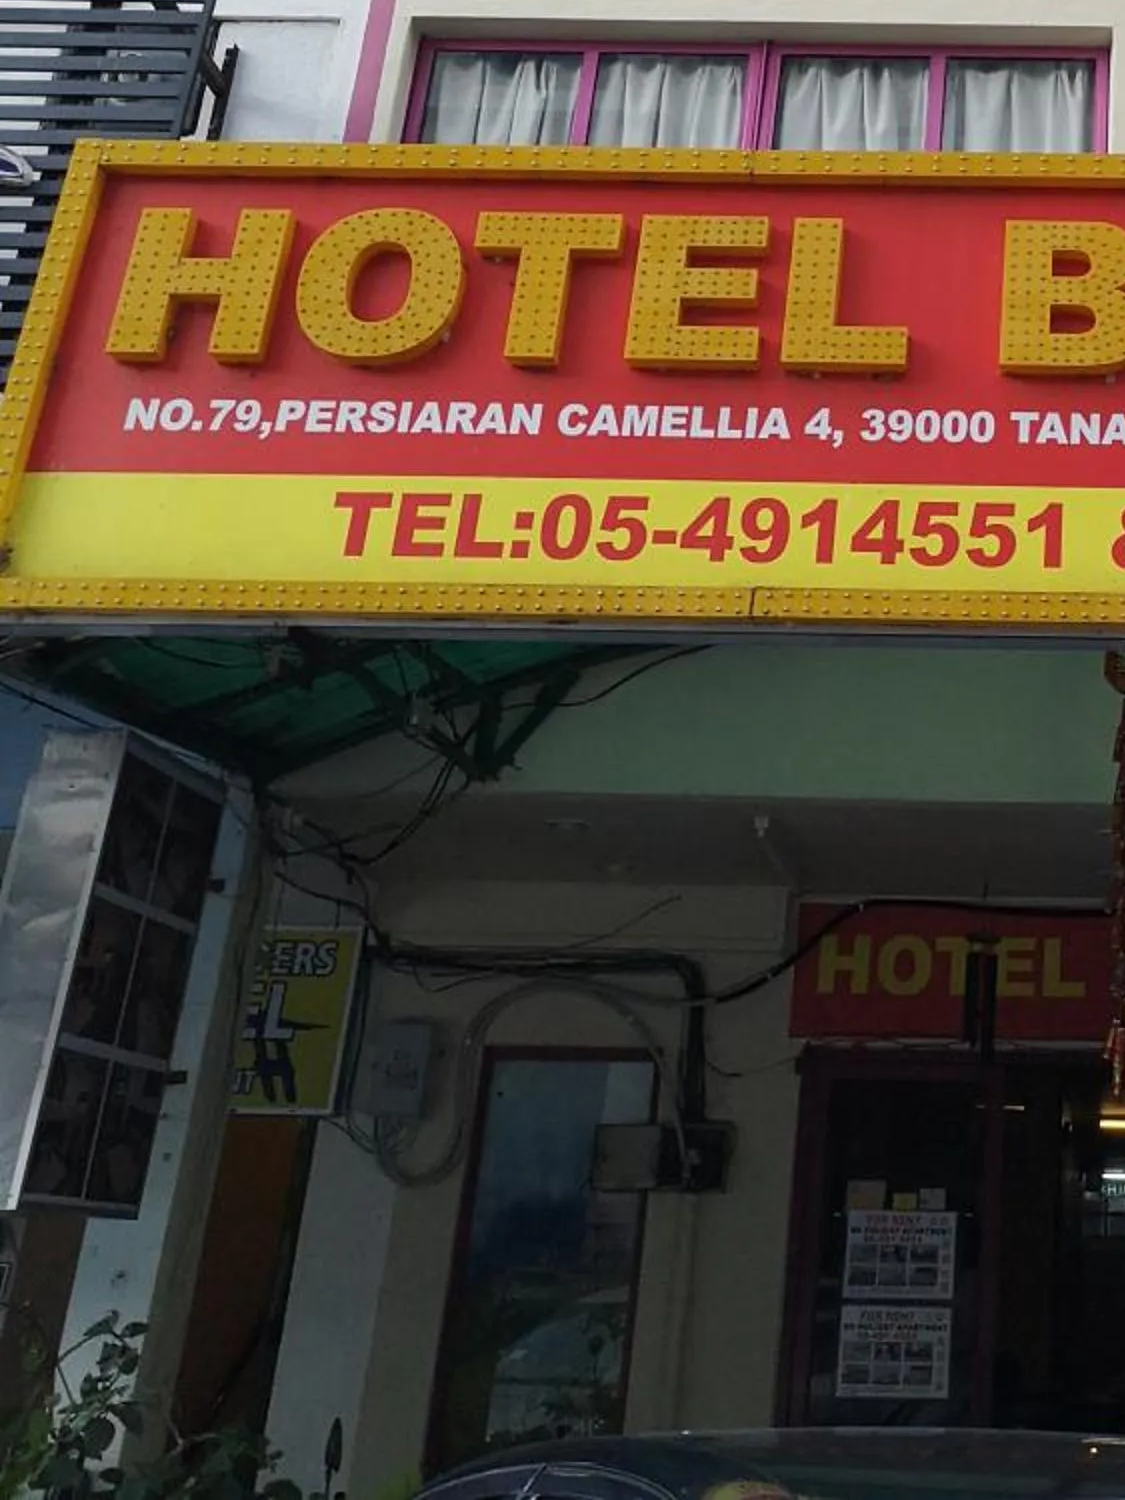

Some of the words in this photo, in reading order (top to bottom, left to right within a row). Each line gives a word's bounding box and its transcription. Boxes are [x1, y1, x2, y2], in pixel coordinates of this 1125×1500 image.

[106, 206, 911, 373] HOTEL
[122, 396, 544, 441] NO.79,PERSIARAN
[556, 402, 792, 440] CAMELLIA
[803, 406, 845, 448] 4,
[859, 408, 996, 444] 39000
[334, 491, 1064, 569] TEL:05-4914551
[258, 939, 339, 977] ERS
[815, 933, 1087, 999] HOTEL
